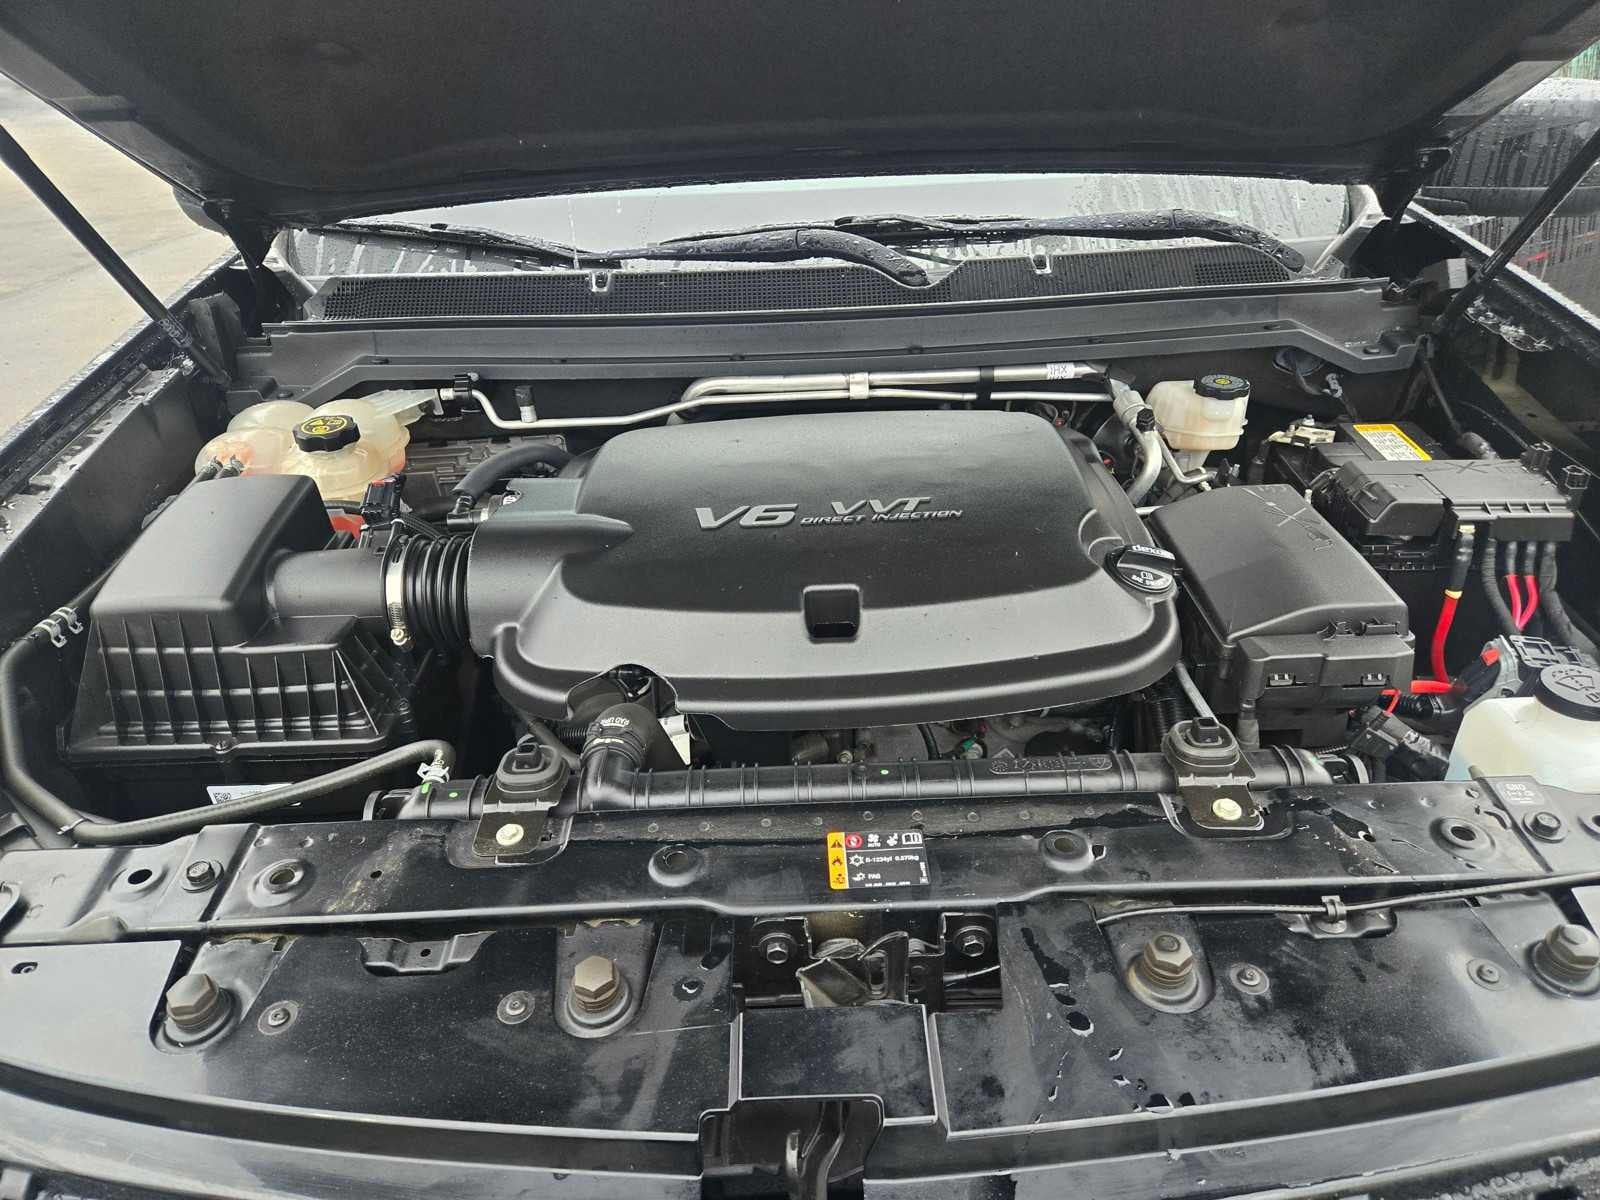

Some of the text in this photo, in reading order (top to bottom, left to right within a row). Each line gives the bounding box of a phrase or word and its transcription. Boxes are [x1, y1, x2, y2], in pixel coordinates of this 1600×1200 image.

[831, 496, 931, 515] VVT
[696, 503, 798, 529] V6
[801, 509, 963, 525] DIRECT INJECTION
